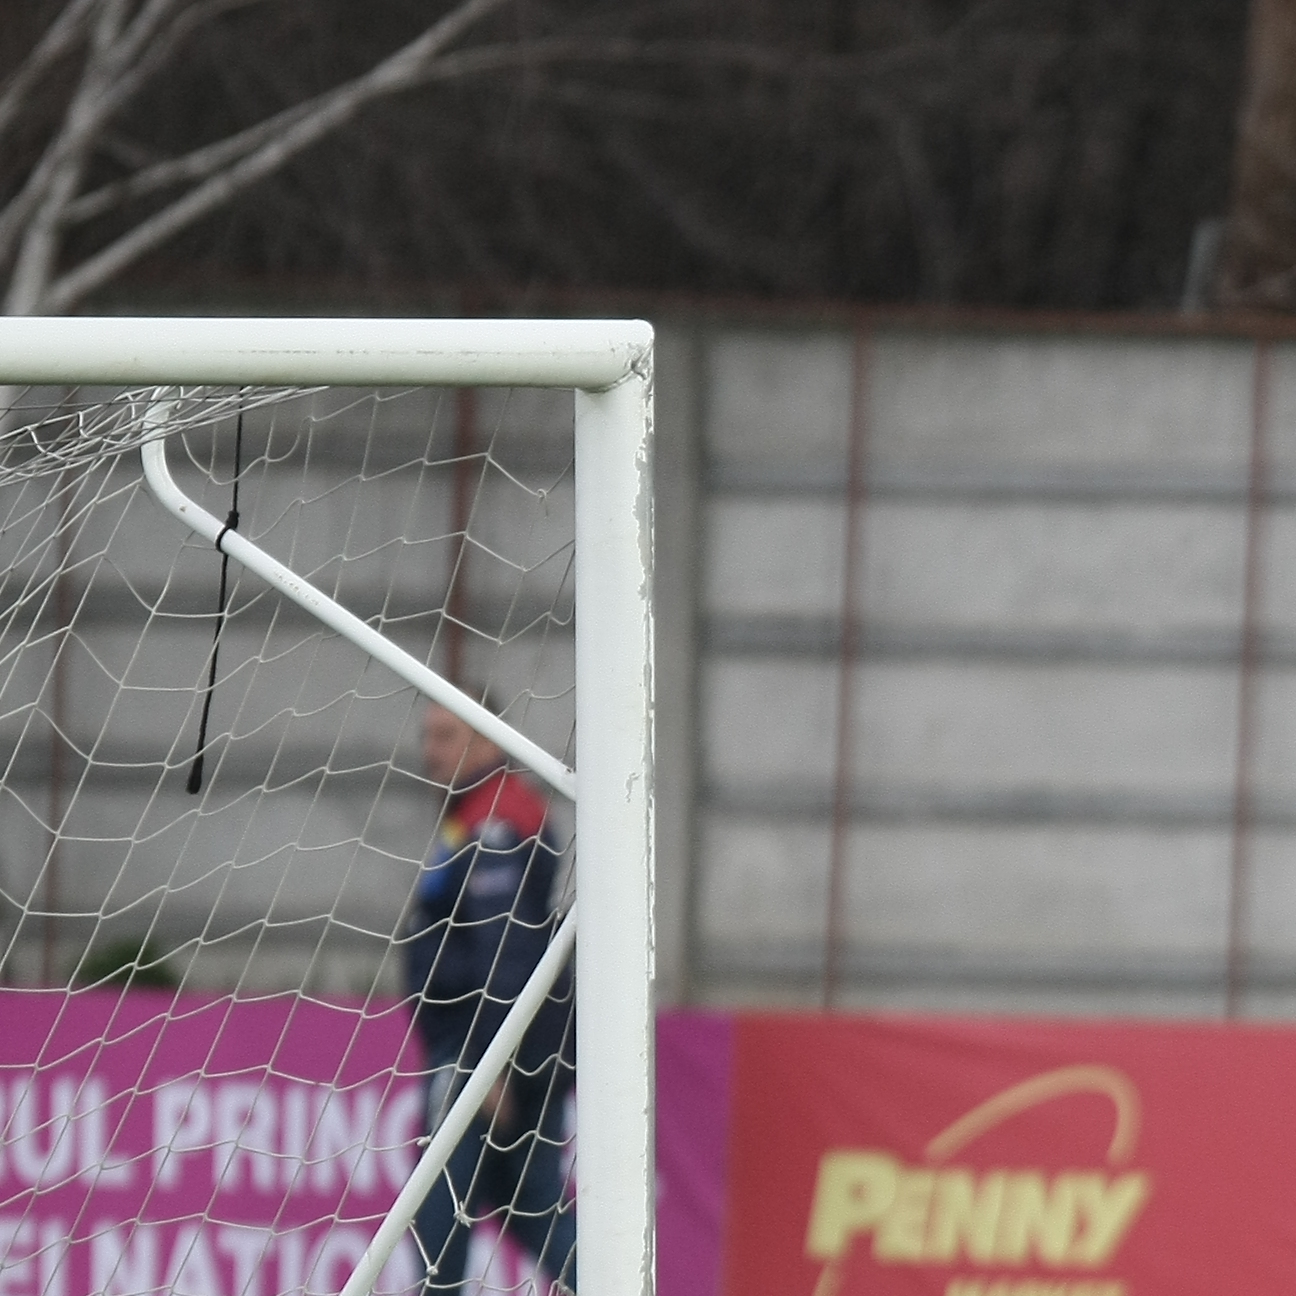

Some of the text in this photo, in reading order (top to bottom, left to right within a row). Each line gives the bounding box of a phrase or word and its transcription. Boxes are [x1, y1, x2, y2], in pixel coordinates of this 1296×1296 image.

[0, 1075, 577, 1195] UL PRINC
[805, 1149, 1150, 1266] PENNY
